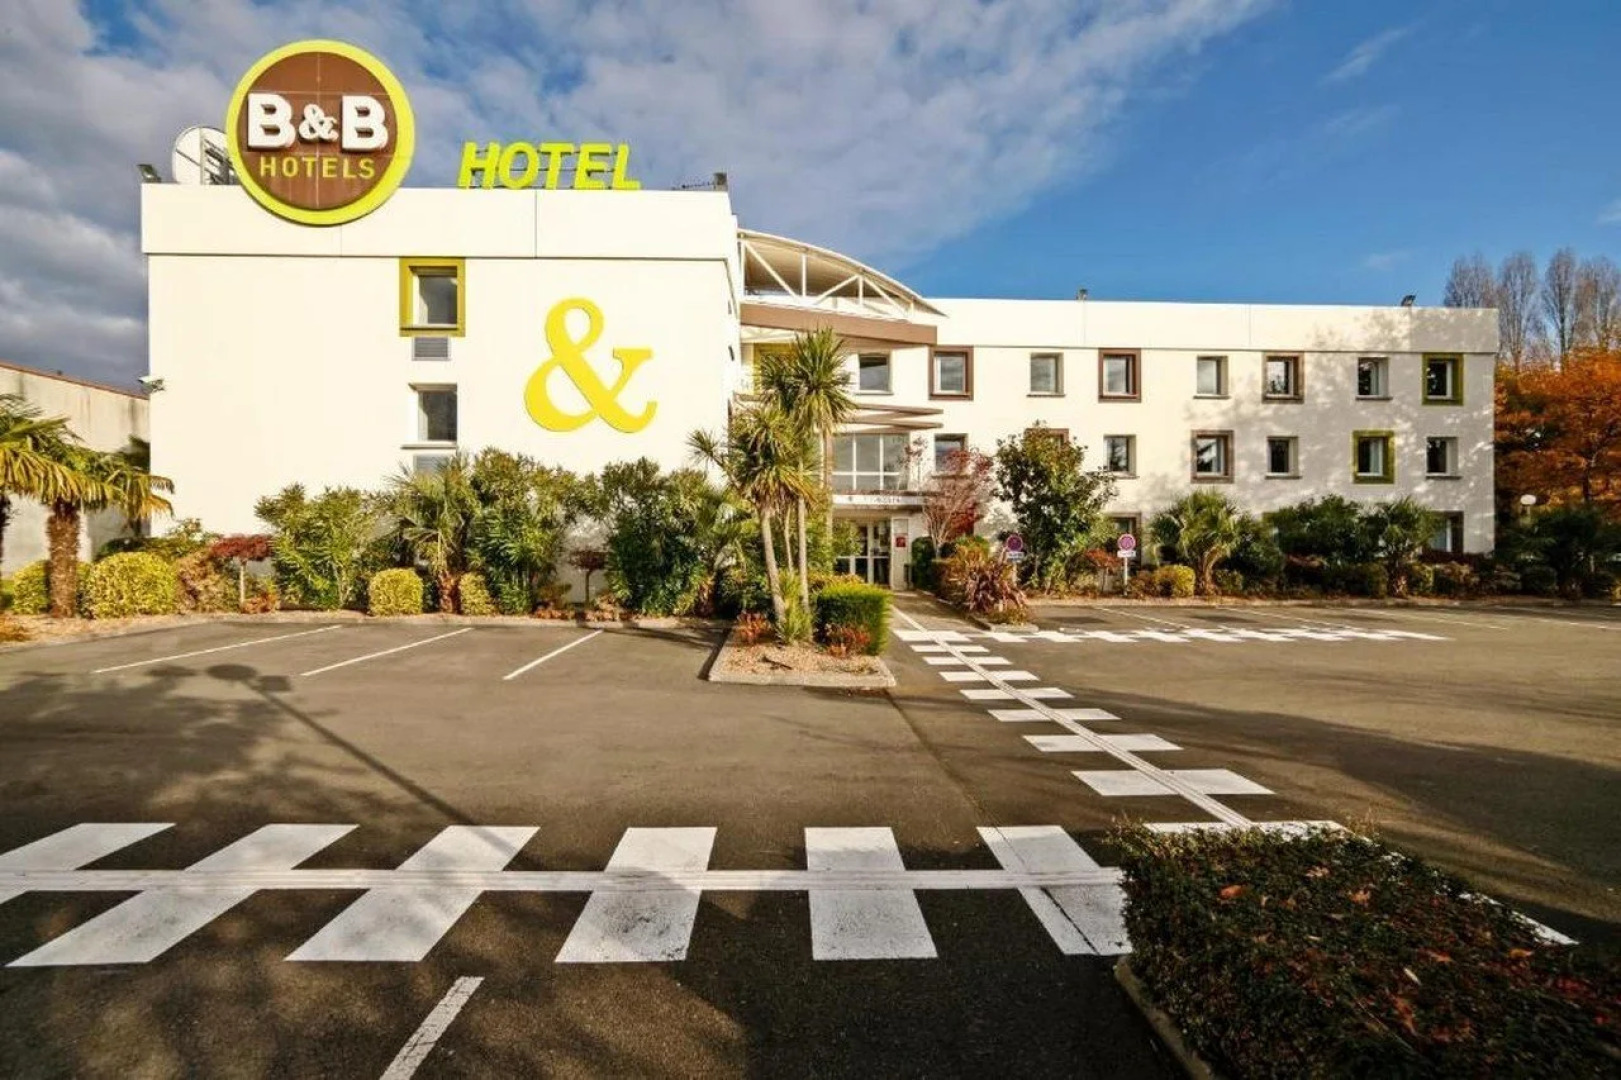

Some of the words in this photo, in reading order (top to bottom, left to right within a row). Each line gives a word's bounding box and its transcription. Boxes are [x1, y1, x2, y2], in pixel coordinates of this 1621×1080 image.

[247, 93, 389, 149] B&B
[260, 156, 376, 179] HOTELS
[457, 141, 641, 190] HOTEL
[523, 297, 657, 433] &
